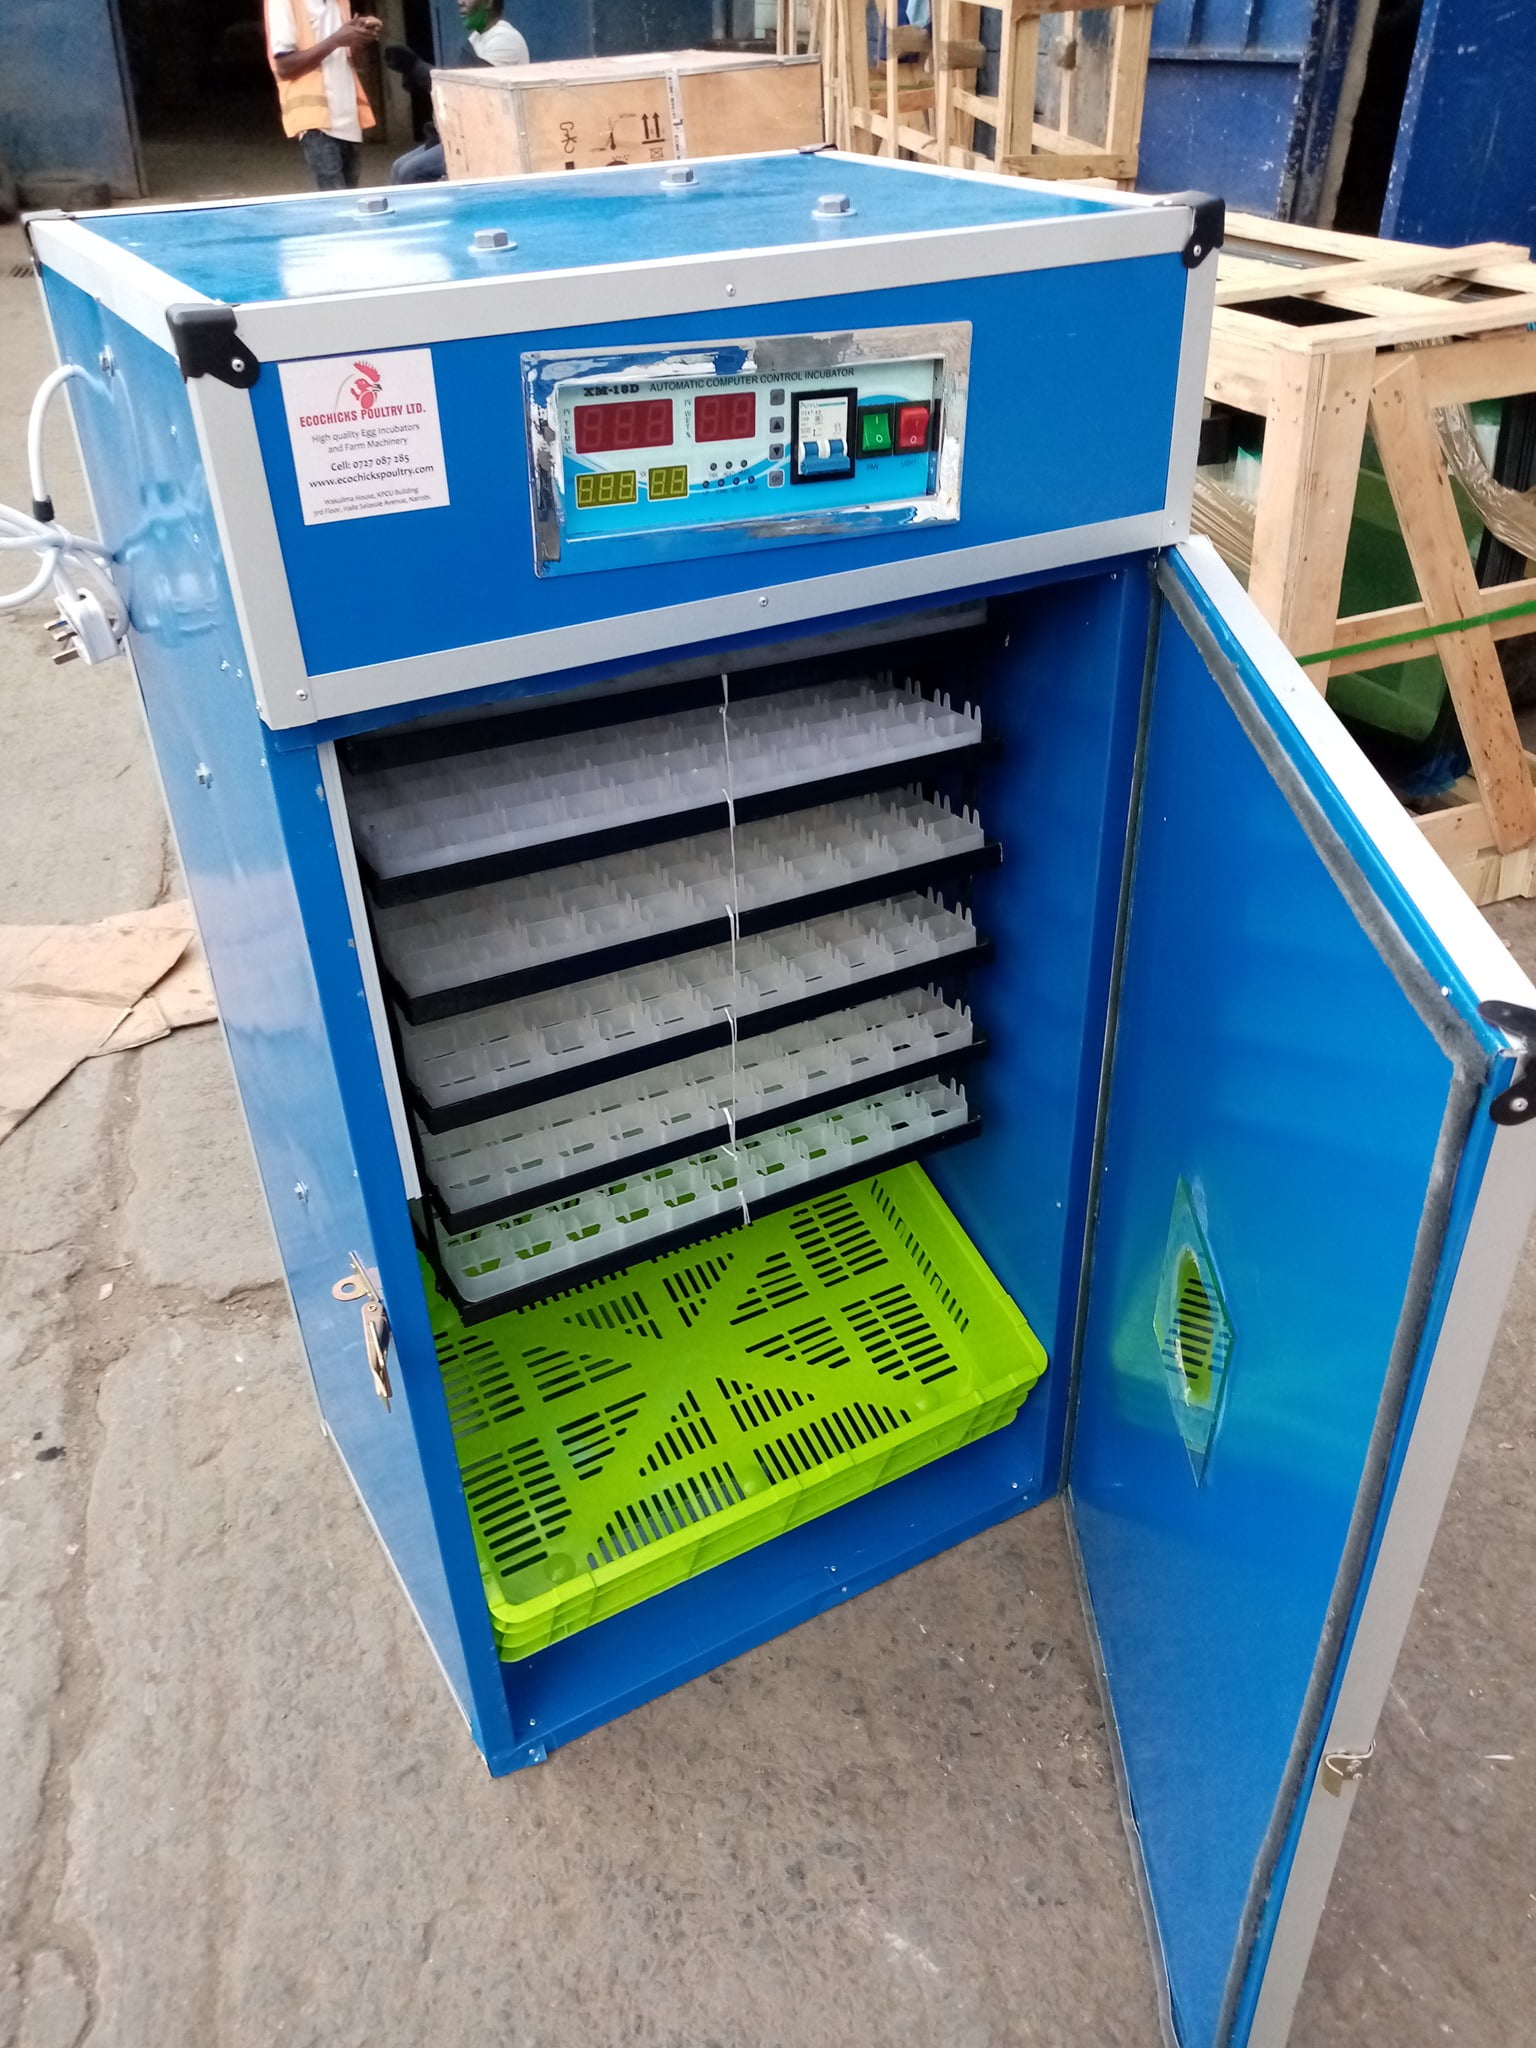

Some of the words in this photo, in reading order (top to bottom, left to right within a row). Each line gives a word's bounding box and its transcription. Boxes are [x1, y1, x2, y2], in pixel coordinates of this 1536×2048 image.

[583, 383, 640, 397] XM-18D
[649, 378, 706, 393] AUTOMATIC
[706, 375, 759, 388] COMPUTER
[760, 373, 803, 384] CONTROL
[804, 368, 855, 381] INCUBATOR
[299, 410, 358, 427] ECOCHICKS
[361, 405, 403, 420] POULTRY
[406, 402, 426, 415] LTD.
[312, 433, 331, 444] High
[332, 430, 360, 442] quality
[361, 428, 377, 438] Egg
[378, 423, 420, 434] Incubators
[328, 444, 343, 453] and
[345, 442, 366, 452] Farm
[367, 437, 408, 449] Machinery
[331, 461, 351, 472] Cell:
[353, 459, 373, 469] 0727
[375, 456, 392, 466] 087
[394, 454, 410, 463] 285
[308, 464, 434, 488] www.ecochickspoultry.com
